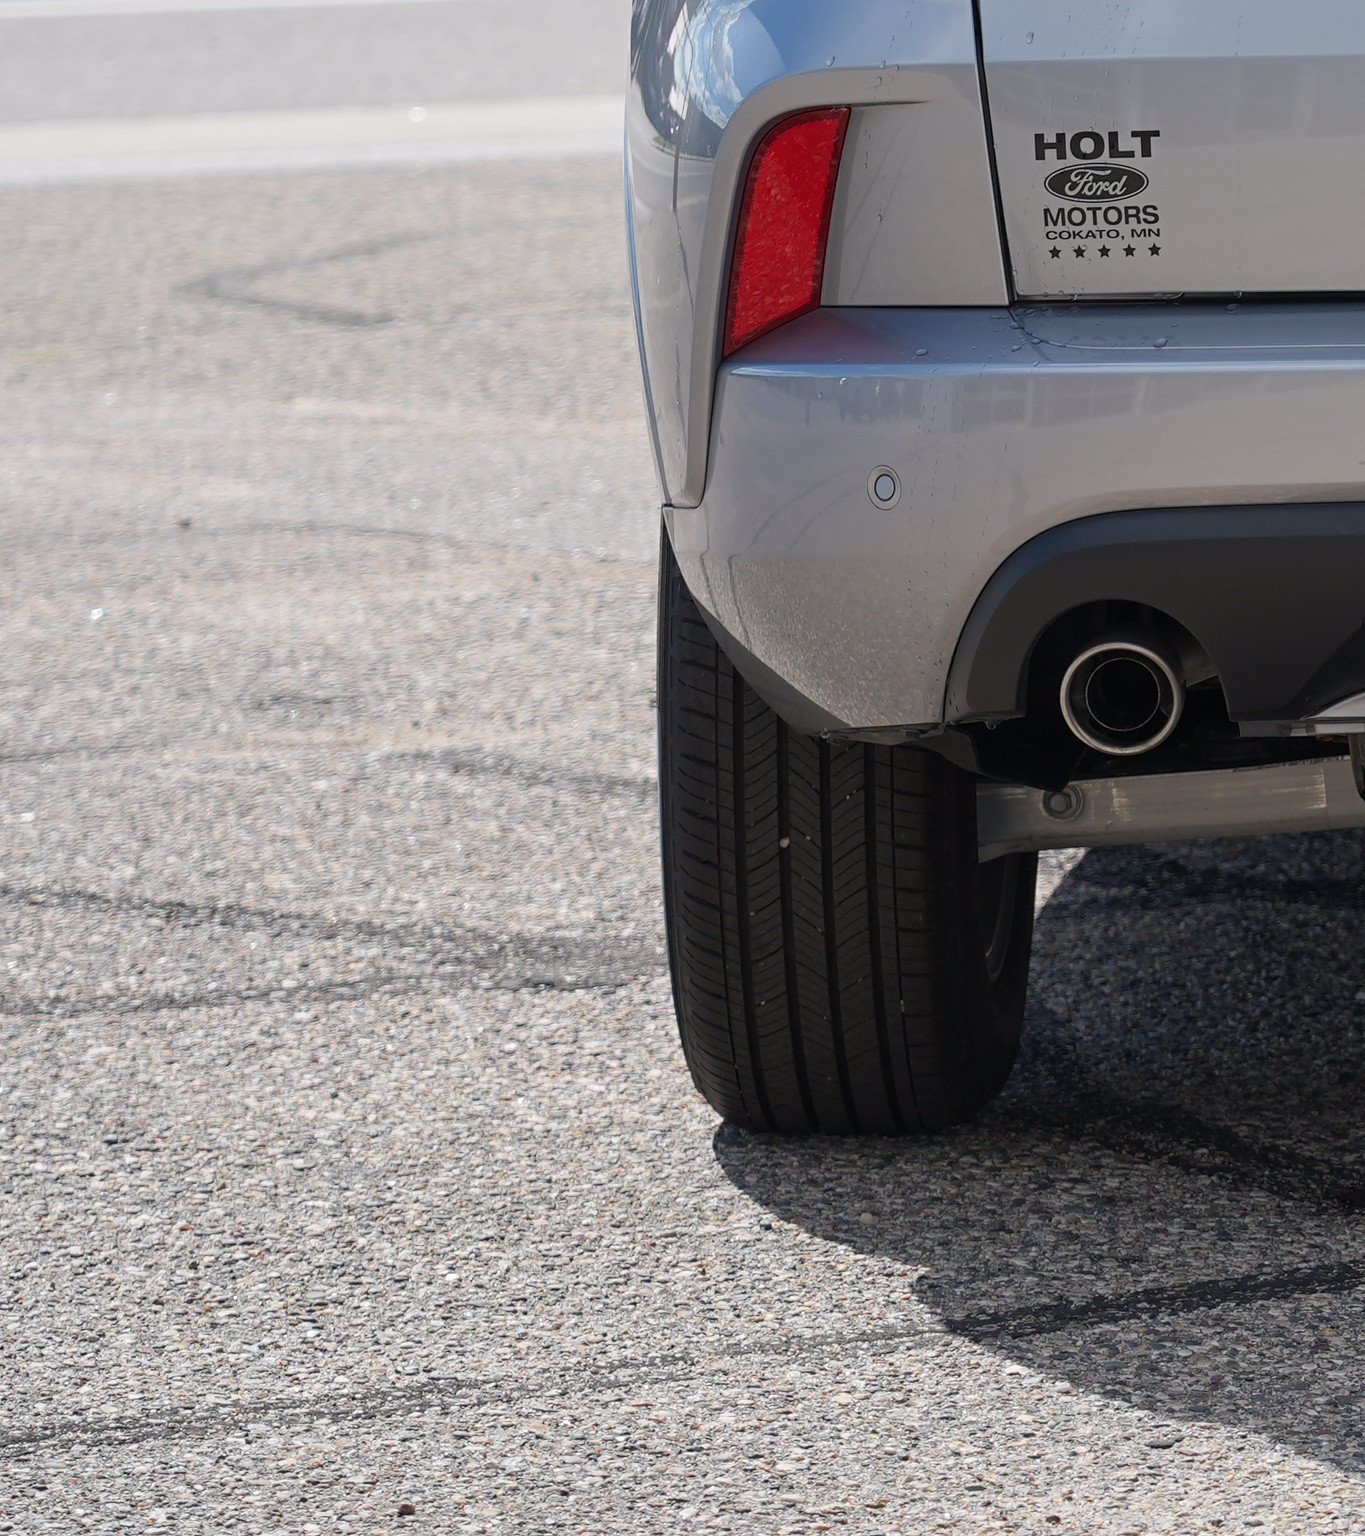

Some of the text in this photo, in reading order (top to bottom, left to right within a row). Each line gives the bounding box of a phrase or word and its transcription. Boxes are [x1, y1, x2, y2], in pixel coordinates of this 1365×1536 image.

[1034, 130, 1160, 161] HOLT
[1064, 168, 1129, 196] Ford
[1043, 205, 1160, 227] MOTORS
[1045, 228, 1161, 240] COKATO, MN
